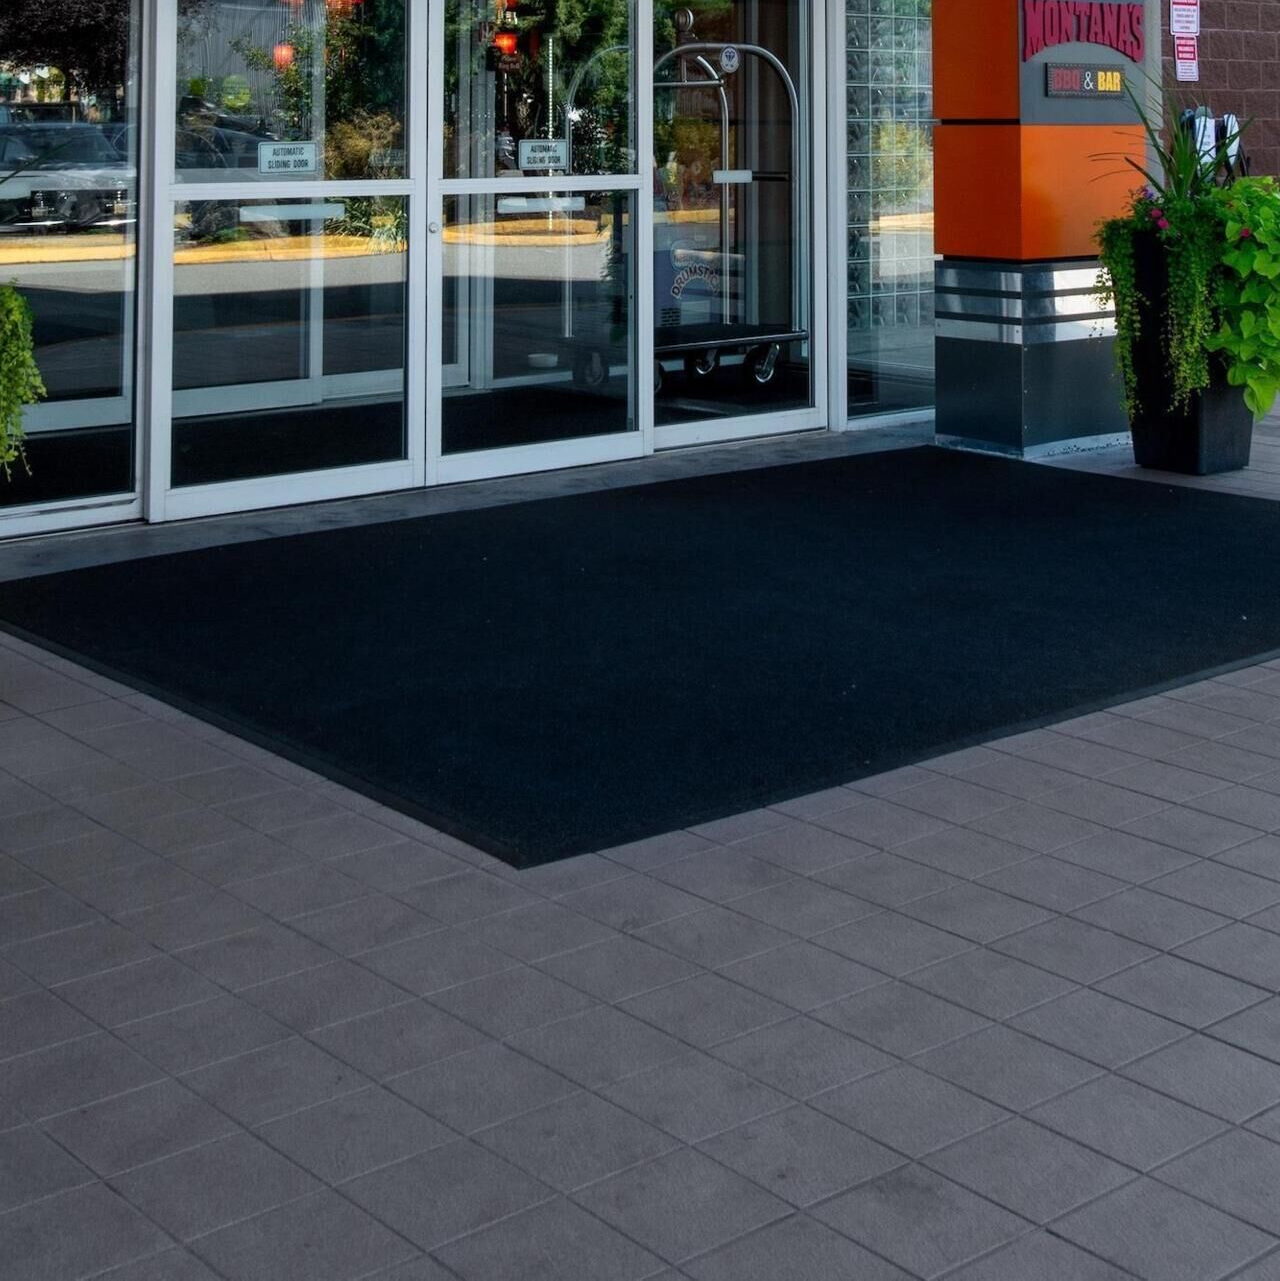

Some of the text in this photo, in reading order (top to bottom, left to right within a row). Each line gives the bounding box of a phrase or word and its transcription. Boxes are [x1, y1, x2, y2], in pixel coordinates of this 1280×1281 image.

[1083, 71, 1094, 90] &
[1097, 71, 1121, 92] BAR
[272, 147, 305, 157] AUTOMATIC
[267, 159, 309, 169] SLIDING DOOR
